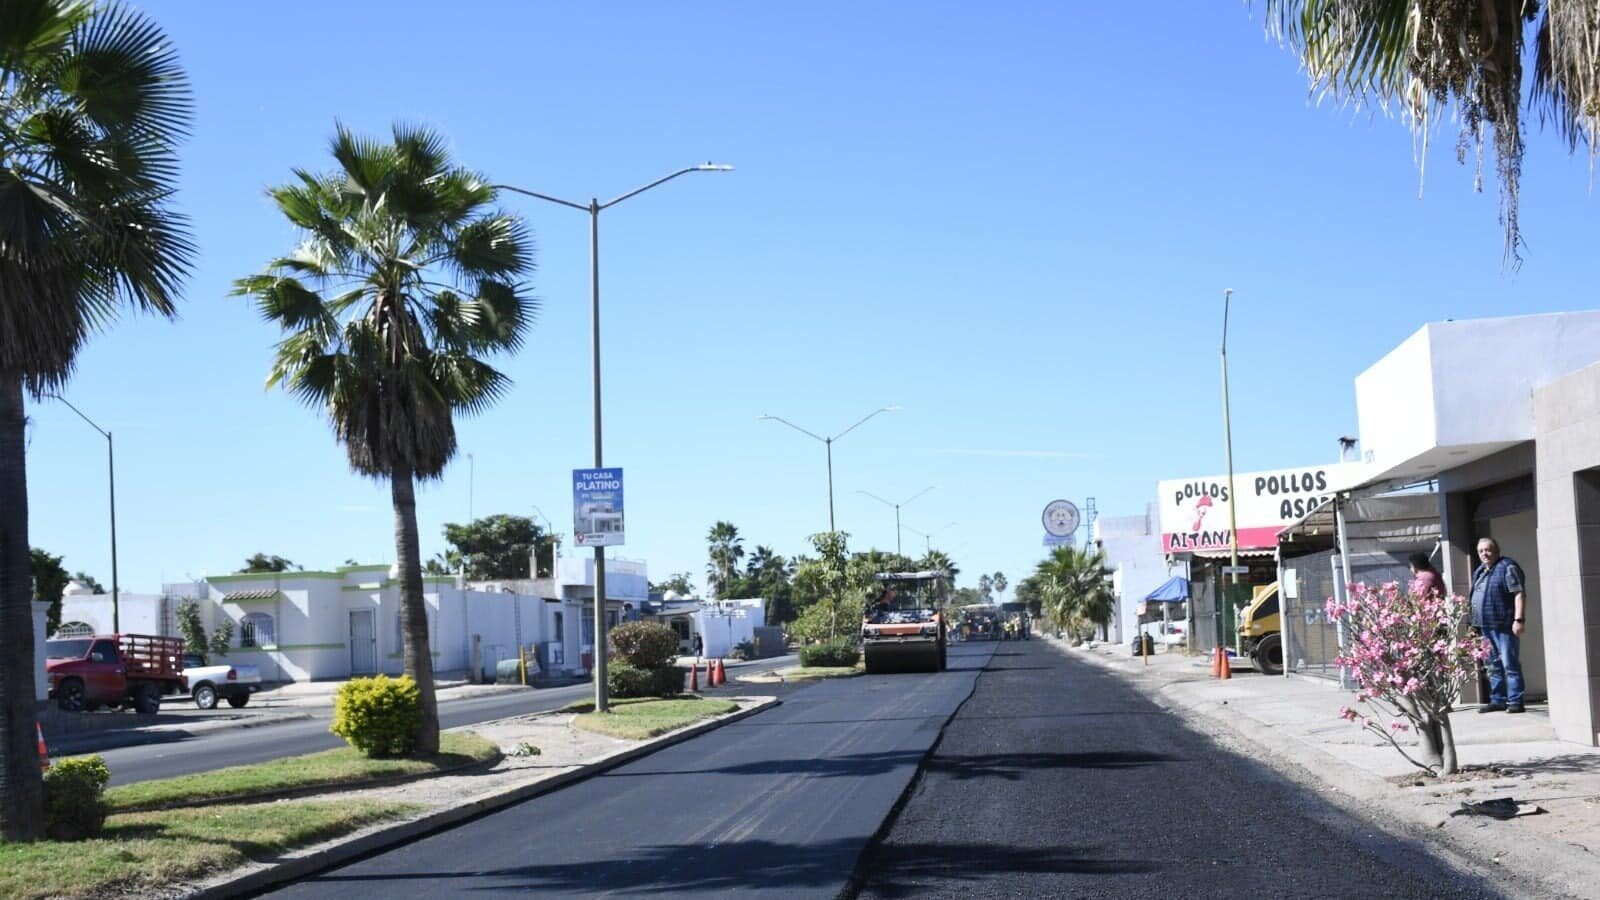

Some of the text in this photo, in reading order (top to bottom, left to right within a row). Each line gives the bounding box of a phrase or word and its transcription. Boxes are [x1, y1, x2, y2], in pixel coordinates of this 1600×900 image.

[593, 472, 613, 480] CASA
[1255, 470, 1327, 496] POLLOS
[576, 480, 620, 491] PLATINO
[1176, 481, 1229, 506] POLLOS
